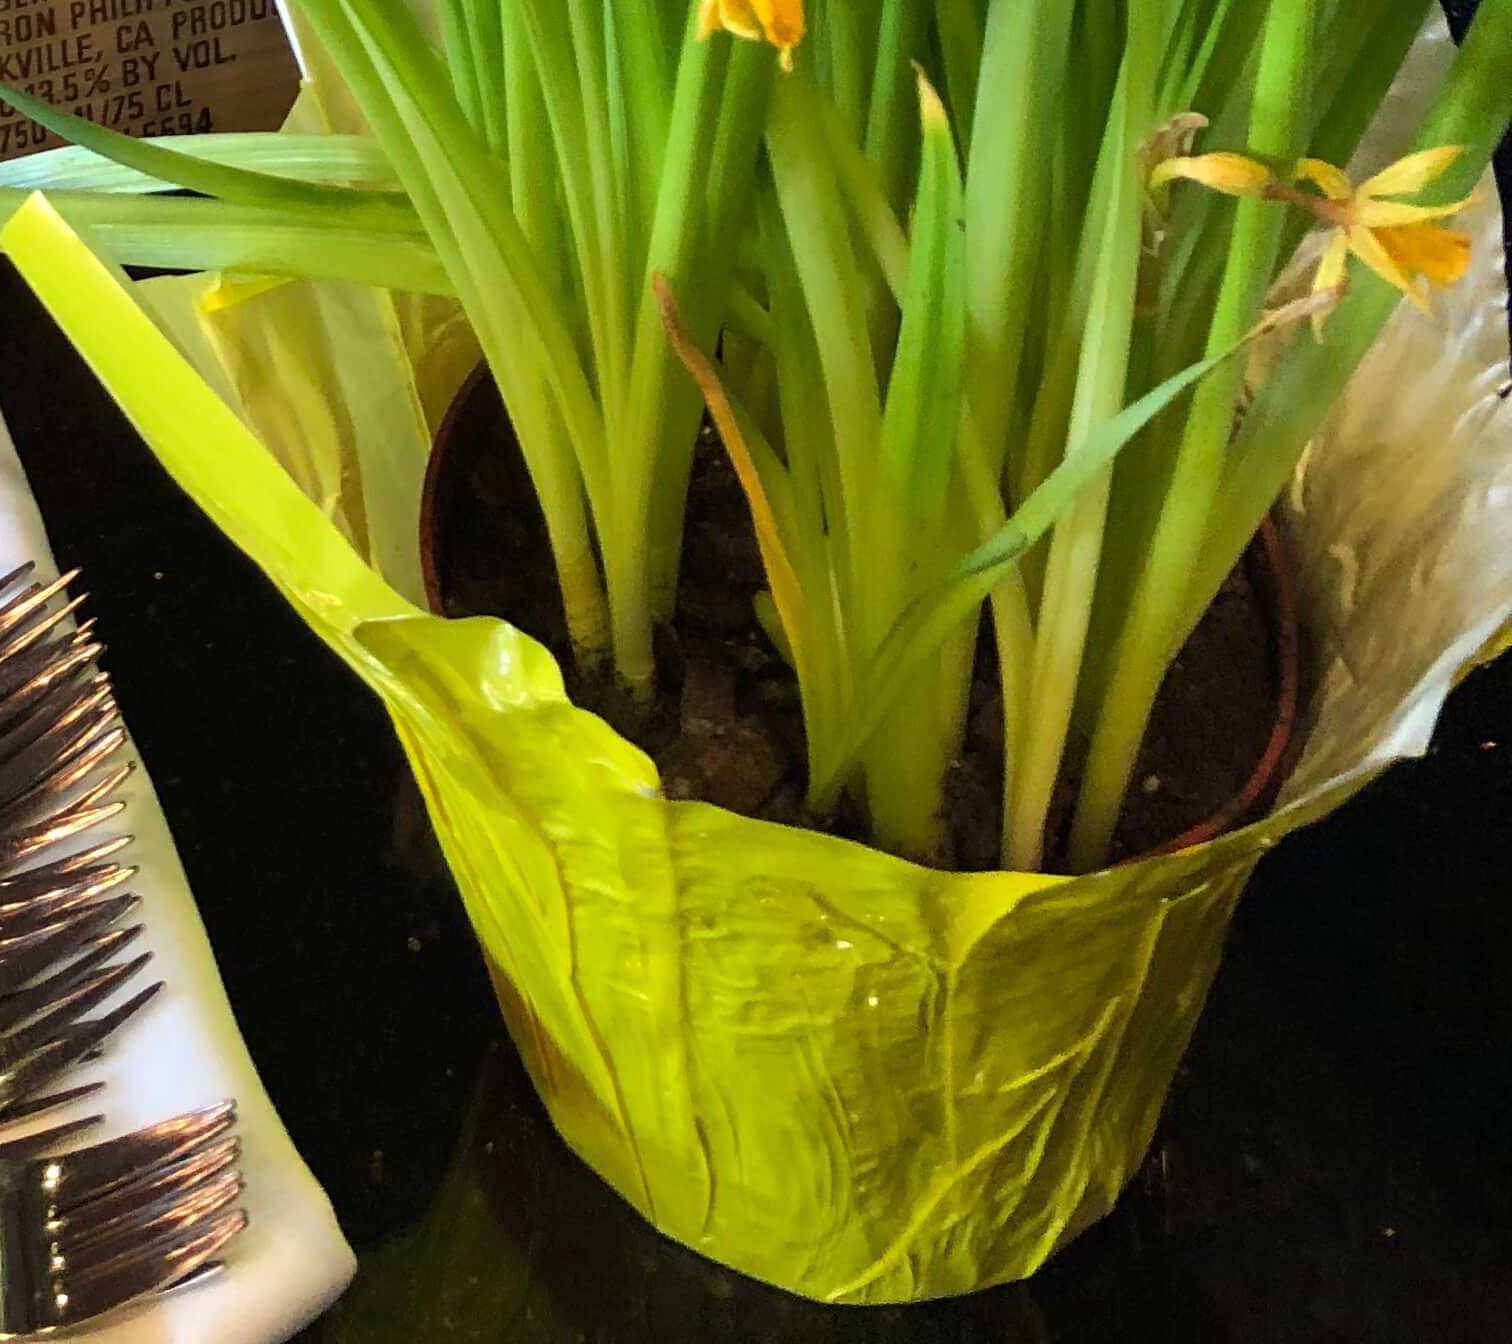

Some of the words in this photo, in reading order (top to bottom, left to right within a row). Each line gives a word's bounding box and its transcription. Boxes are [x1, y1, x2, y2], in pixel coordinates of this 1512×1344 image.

[115, 20, 154, 53] CA
[123, 51, 160, 87] BY
[172, 37, 236, 72] VOL.
[74, 91, 144, 126] /75
[156, 80, 192, 112] CL
